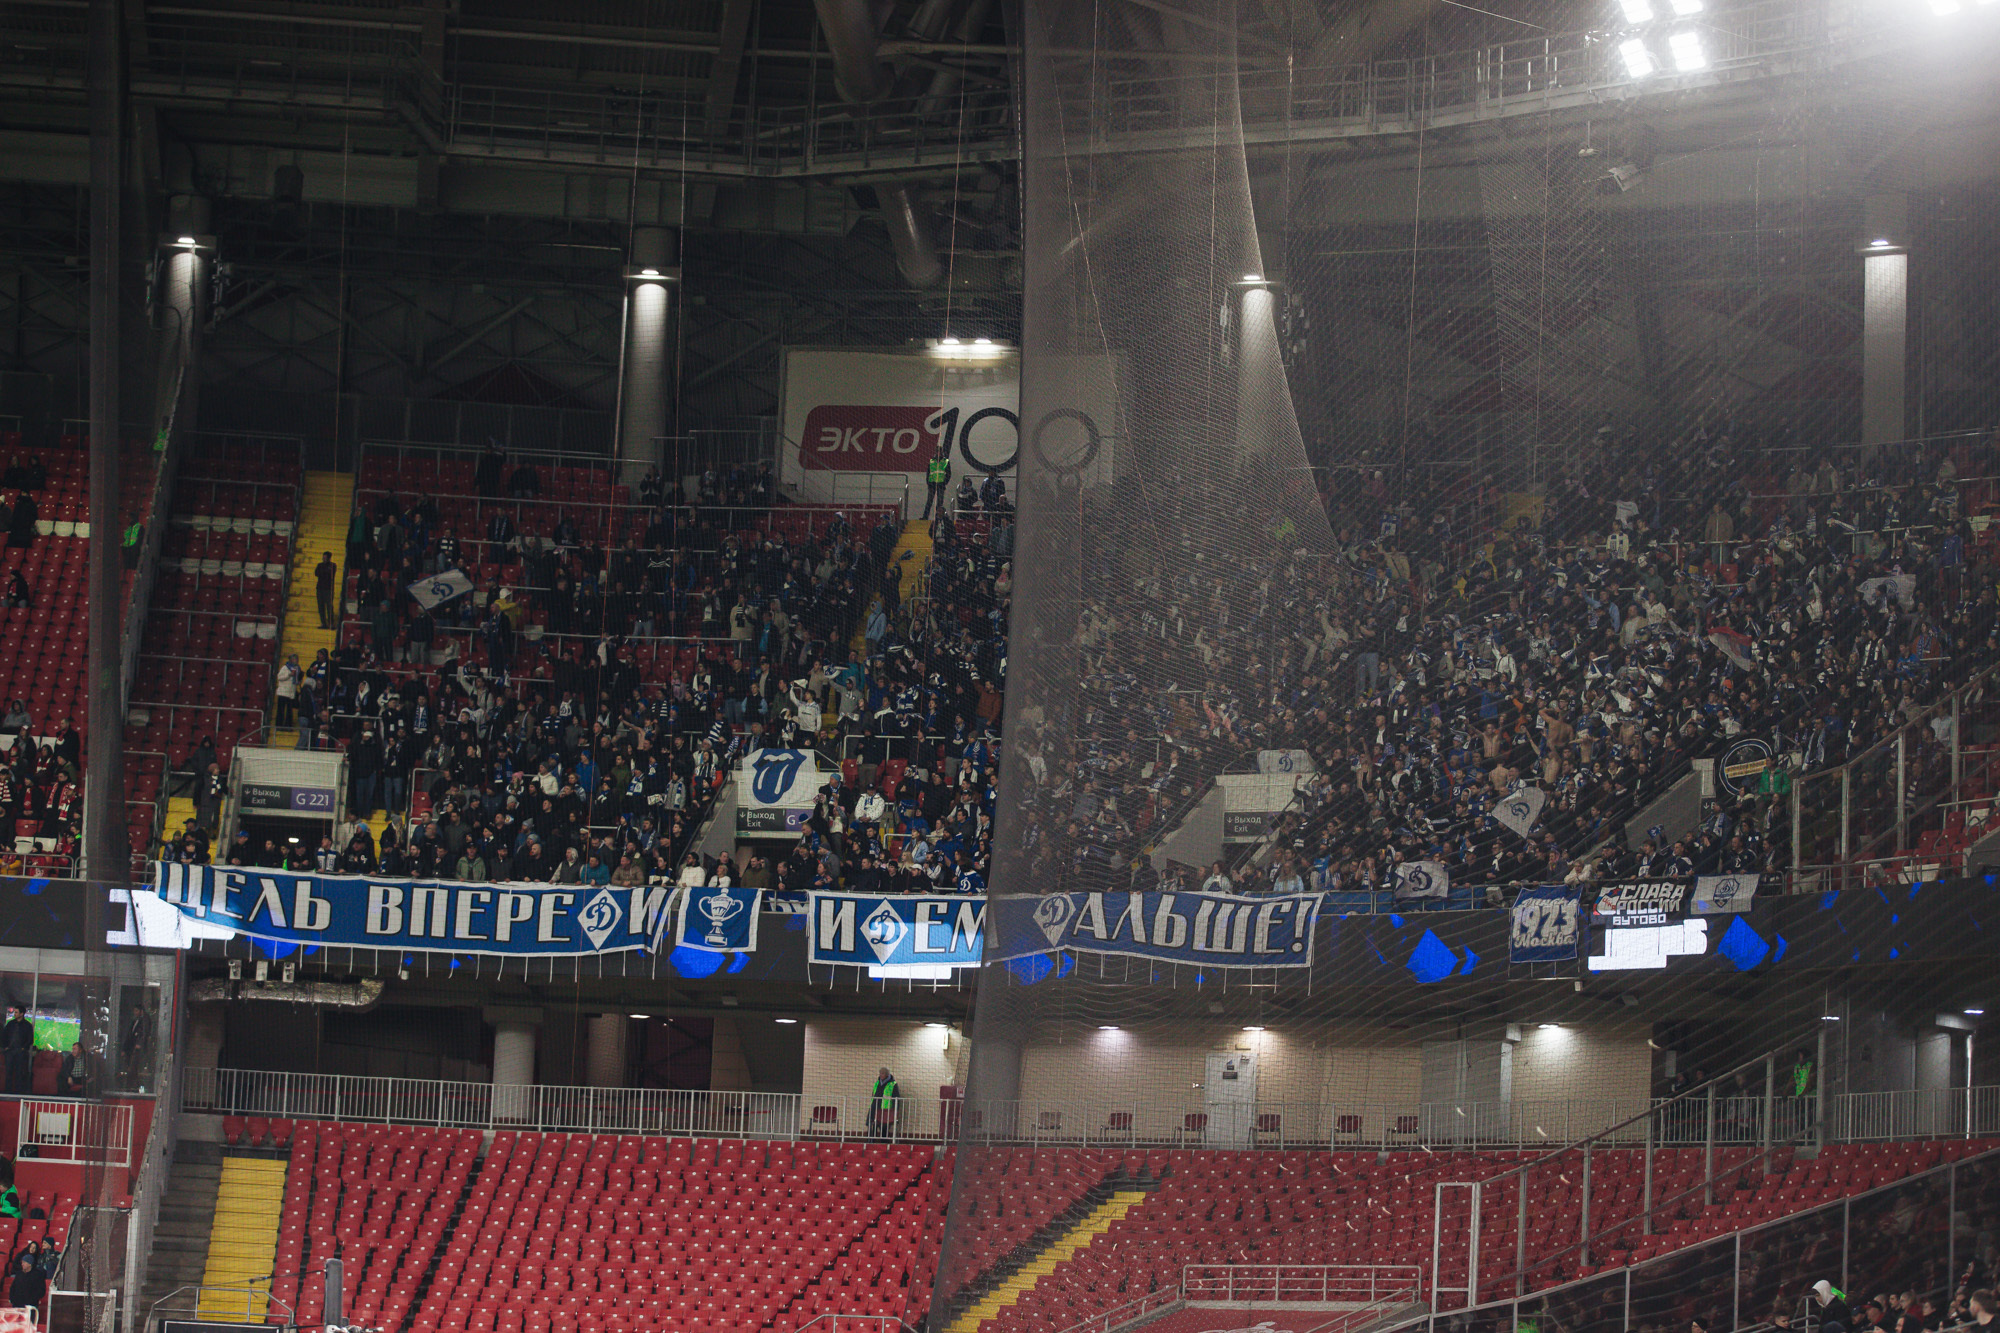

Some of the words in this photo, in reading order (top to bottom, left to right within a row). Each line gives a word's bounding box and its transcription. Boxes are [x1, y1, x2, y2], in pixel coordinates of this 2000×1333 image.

[252, 788, 280, 797] Выход
[296, 793, 306, 805] G
[309, 794, 329, 806] 221
[747, 812, 775, 820] Выход
[1234, 815, 1262, 825] Выход
[1234, 825, 1249, 833] Exit
[165, 862, 332, 932] ЦЕЛЬ
[1619, 881, 1687, 900] СЛАВА
[1616, 897, 1682, 915] РОССИИ
[1512, 902, 1578, 938] 1923
[1612, 913, 1667, 926] БУТОВО
[1514, 931, 1576, 948] Москва
